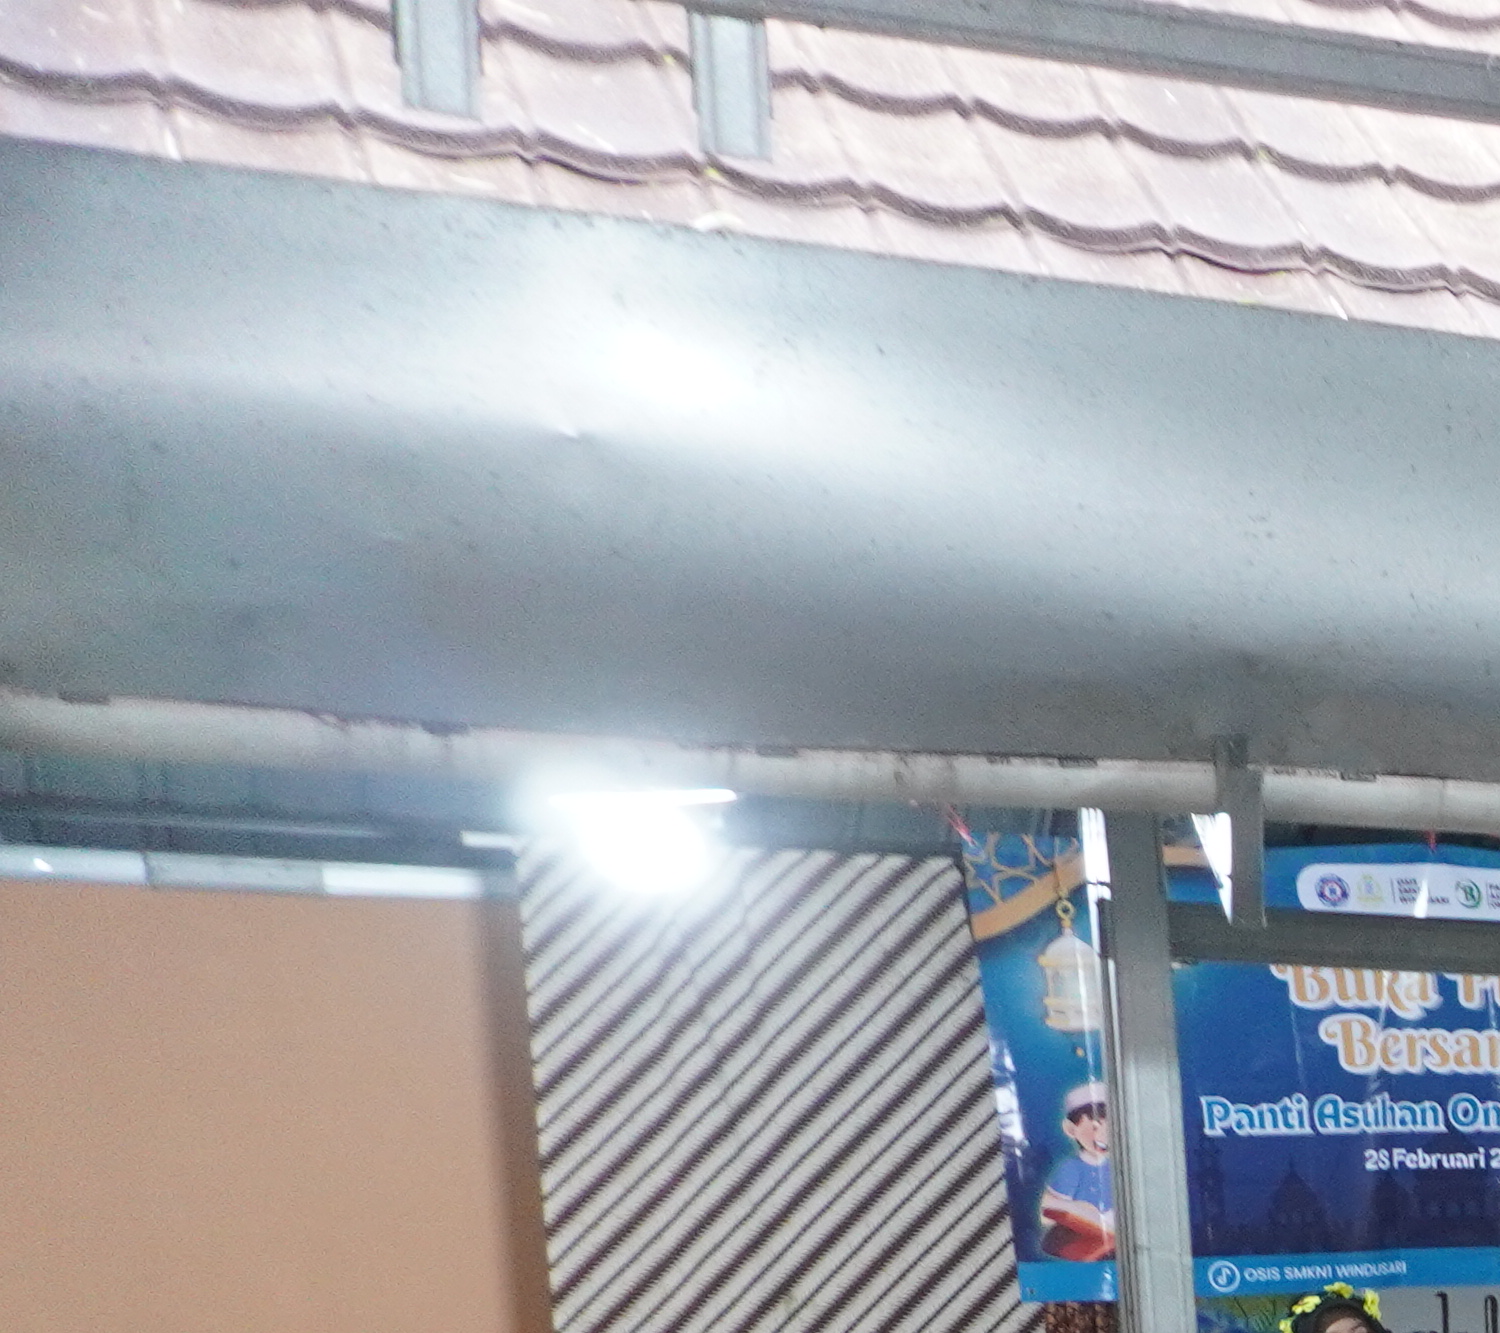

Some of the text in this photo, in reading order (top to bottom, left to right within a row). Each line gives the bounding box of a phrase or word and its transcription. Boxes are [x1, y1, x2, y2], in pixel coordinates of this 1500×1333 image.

[1200, 1092, 1309, 1137] Panti
[1313, 1093, 1448, 1136] Asuhan
[1393, 1147, 1485, 1170] Februari
[1243, 1265, 1280, 1284] OSIS
[1335, 1260, 1407, 1279] WINDUSARI
